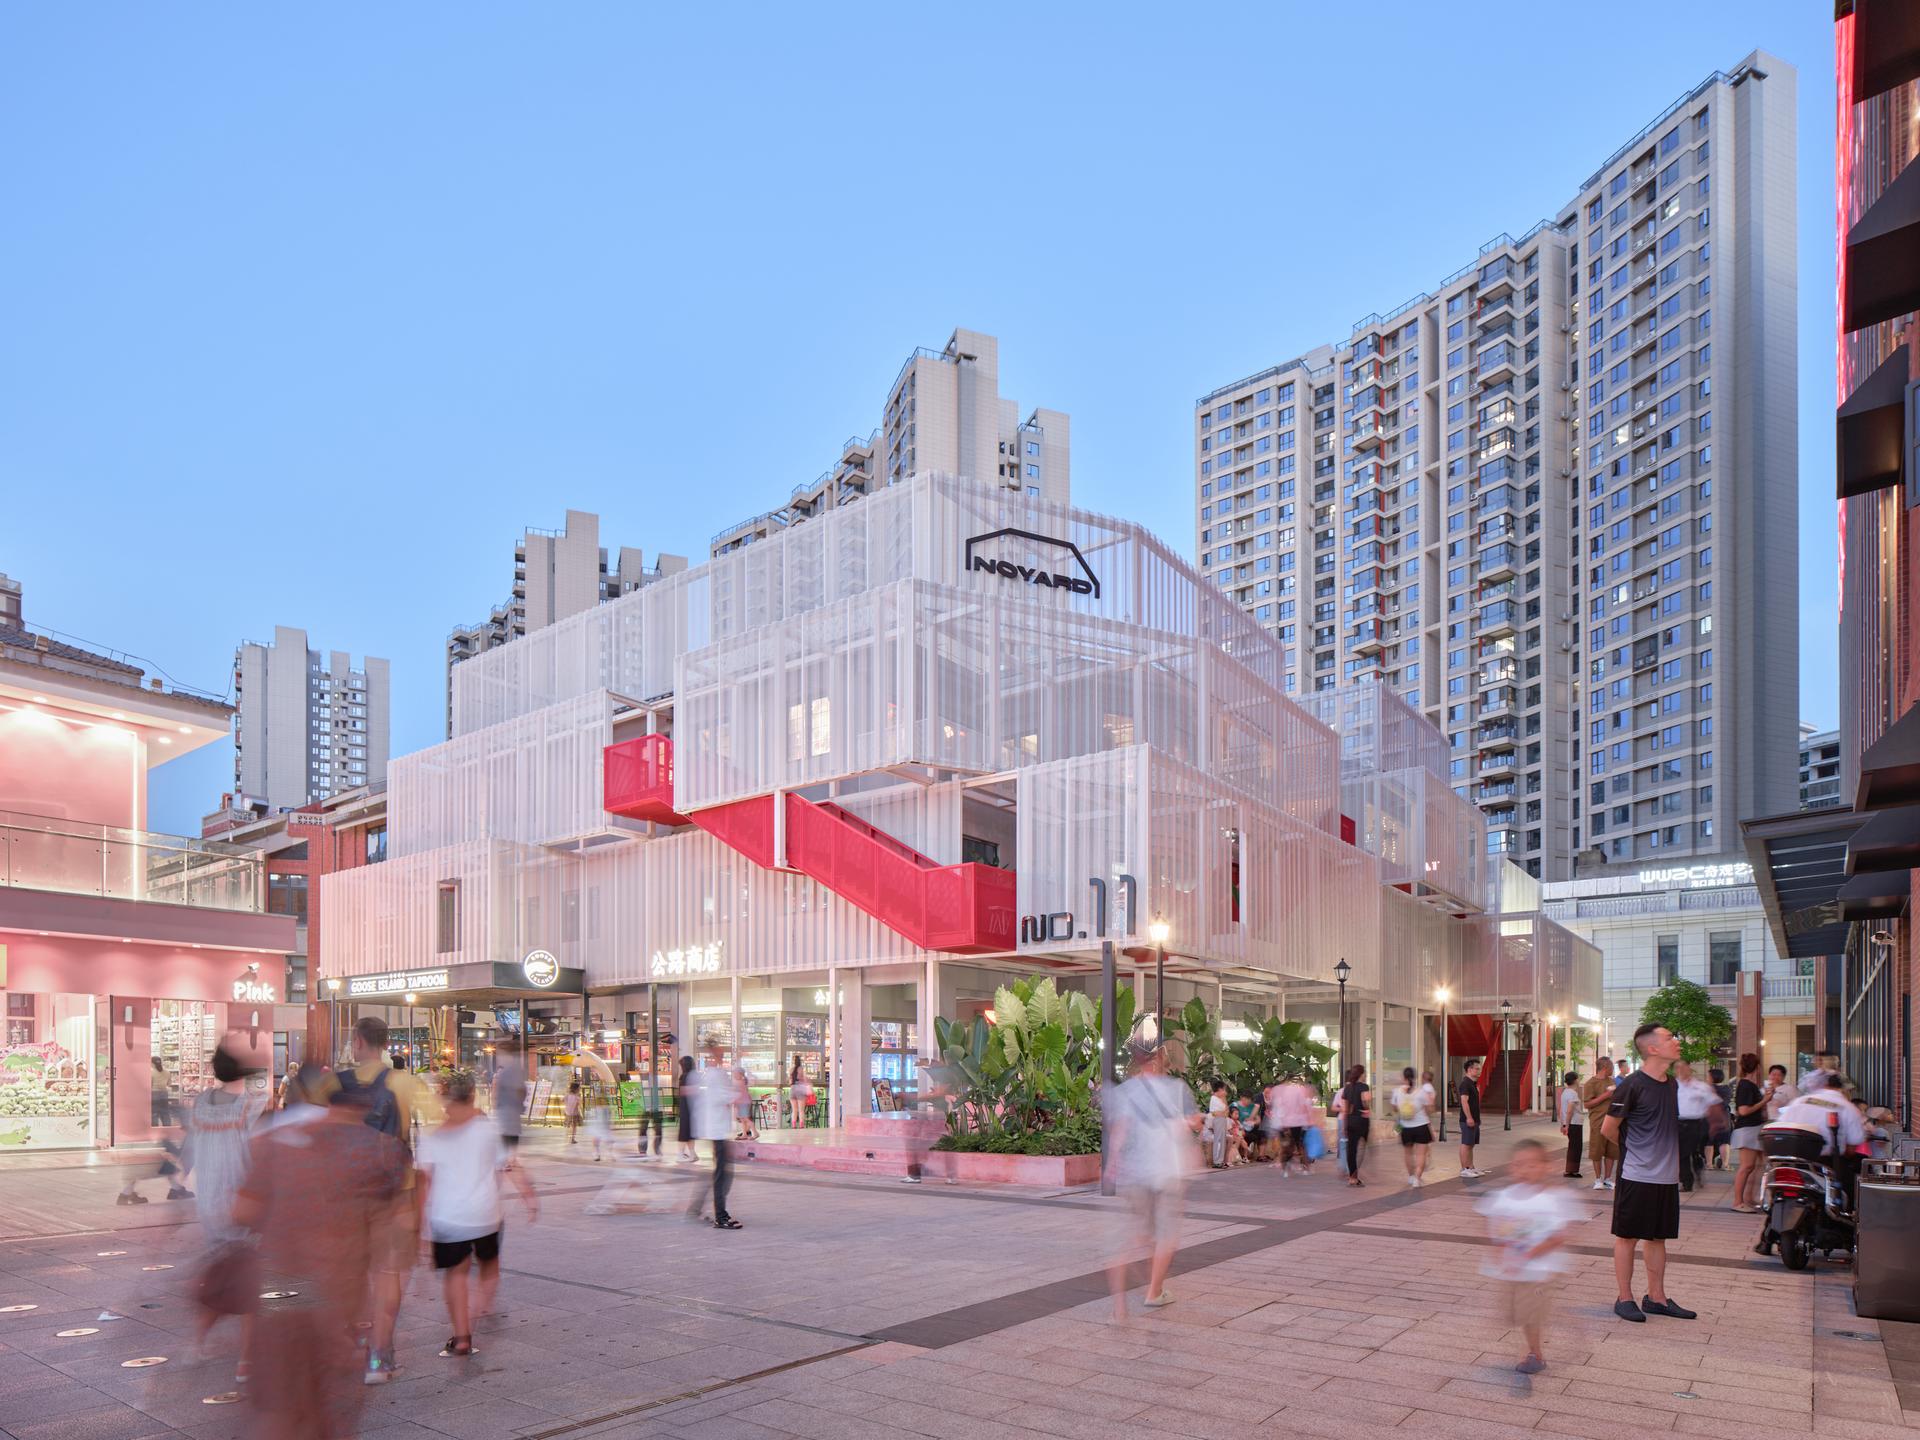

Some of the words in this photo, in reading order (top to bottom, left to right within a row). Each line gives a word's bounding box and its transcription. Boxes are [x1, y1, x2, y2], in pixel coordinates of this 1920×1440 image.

[974, 555, 1093, 595] NOYARD
[651, 943, 721, 977] 公路商店
[233, 980, 275, 1002] Pink
[350, 980, 377, 993] GOOSE
[378, 977, 407, 991] ISLAND
[407, 973, 448, 988] TAPROOM
